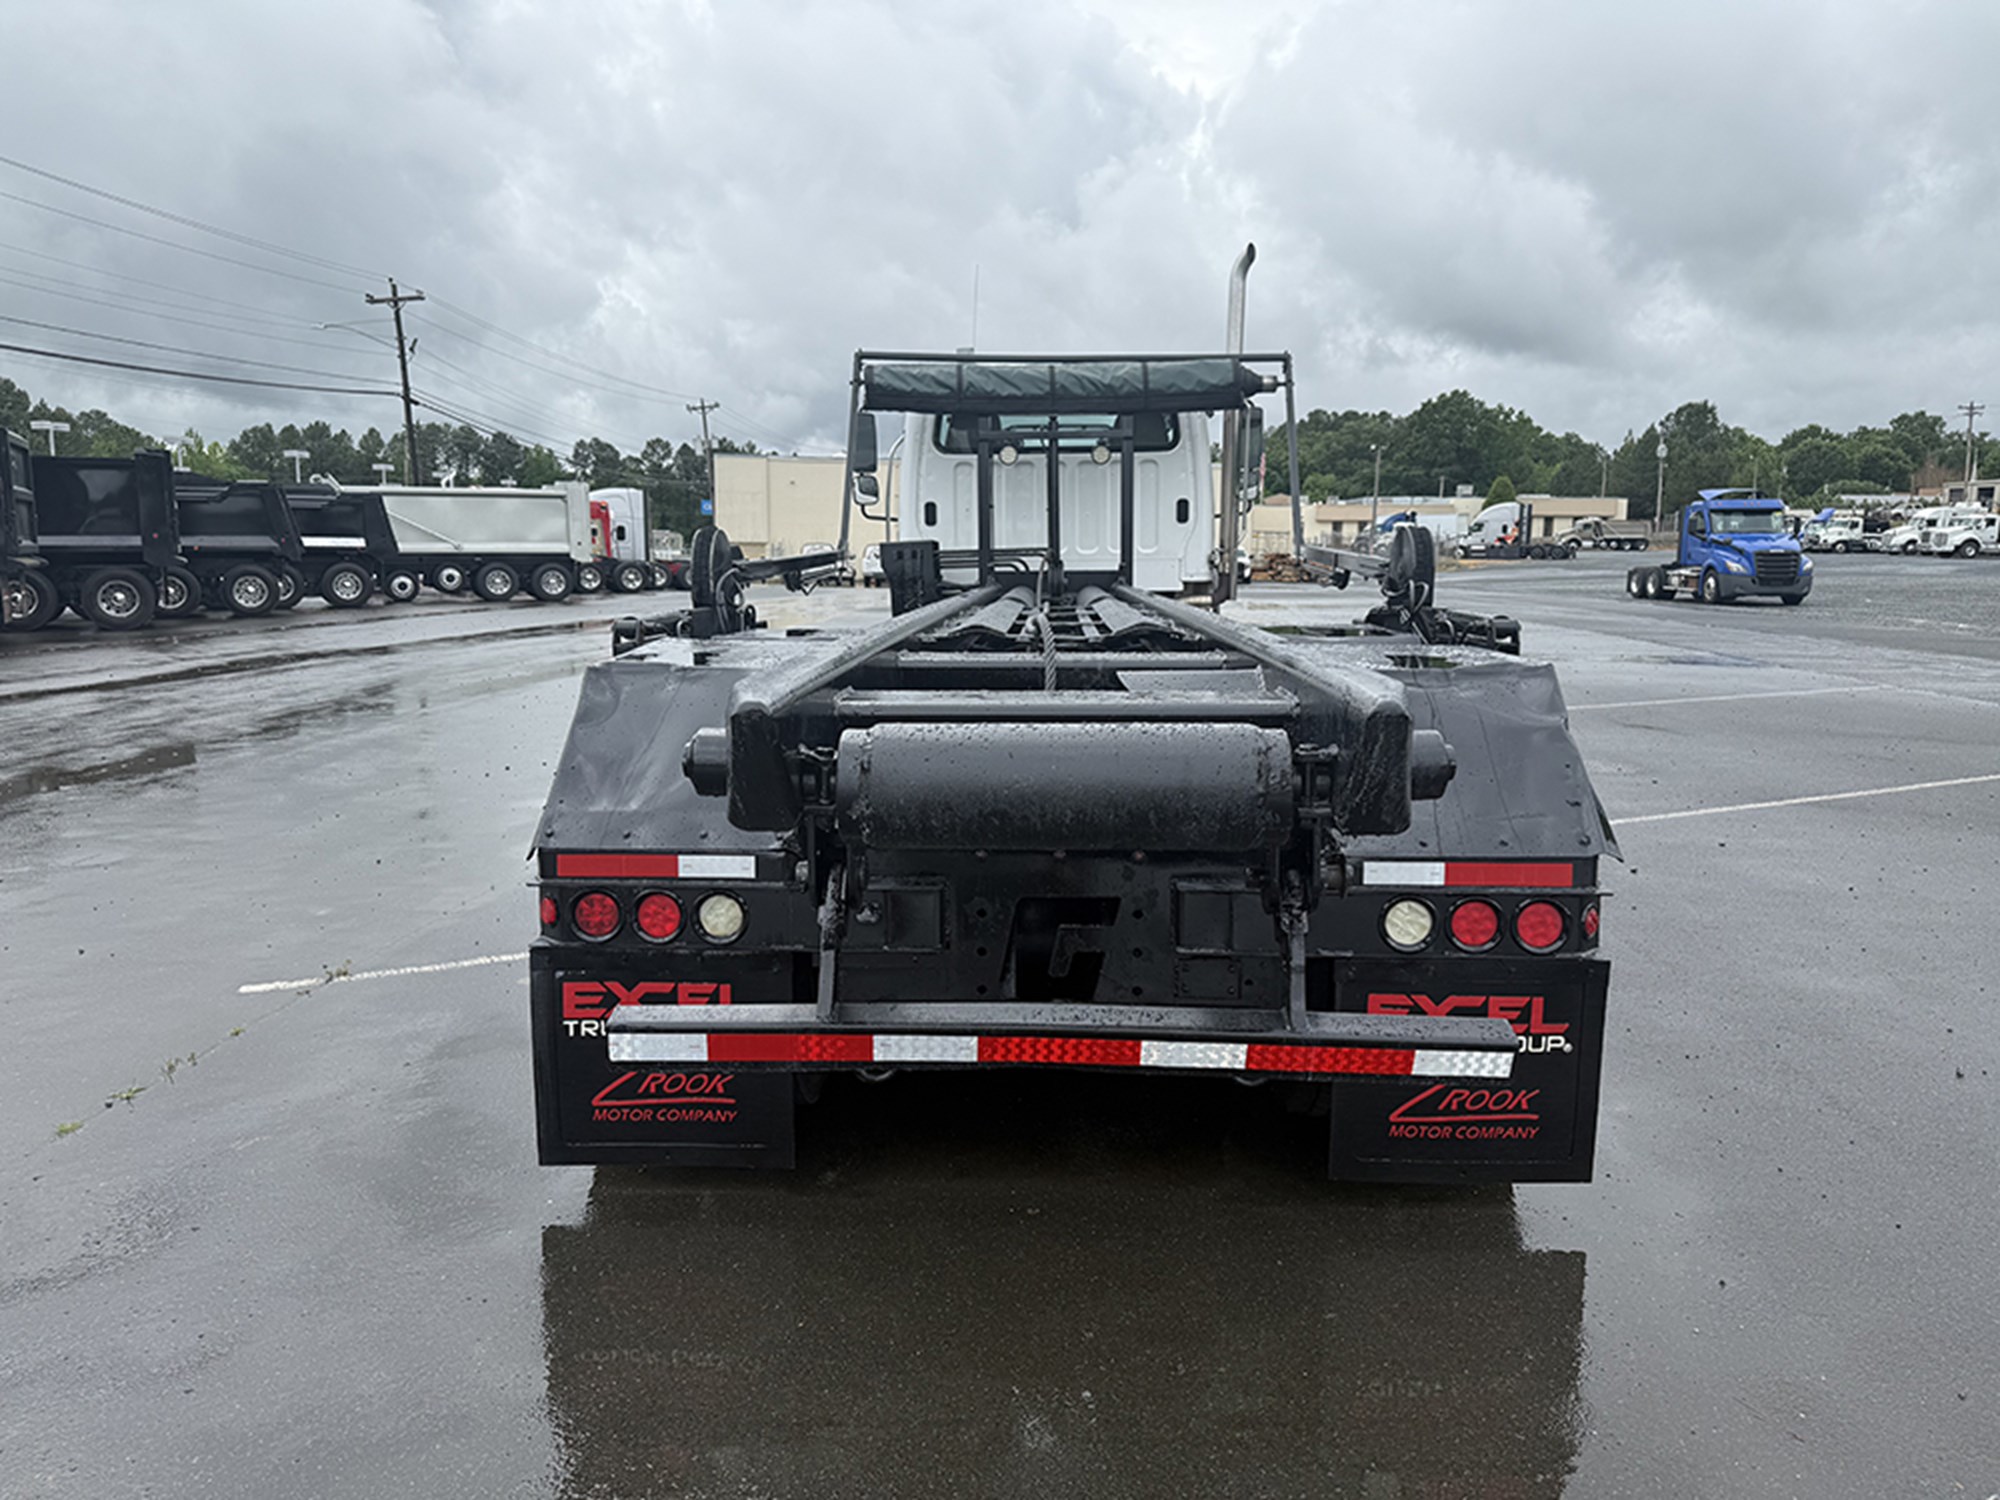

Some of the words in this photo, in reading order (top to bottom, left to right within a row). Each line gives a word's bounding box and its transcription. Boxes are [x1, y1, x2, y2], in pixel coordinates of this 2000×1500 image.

[592, 1108, 653, 1122] MOTOR
[656, 1108, 738, 1122] COMPANY
[1388, 1125, 1452, 1139] MOTOR
[1455, 1126, 1540, 1140] COMPANY
